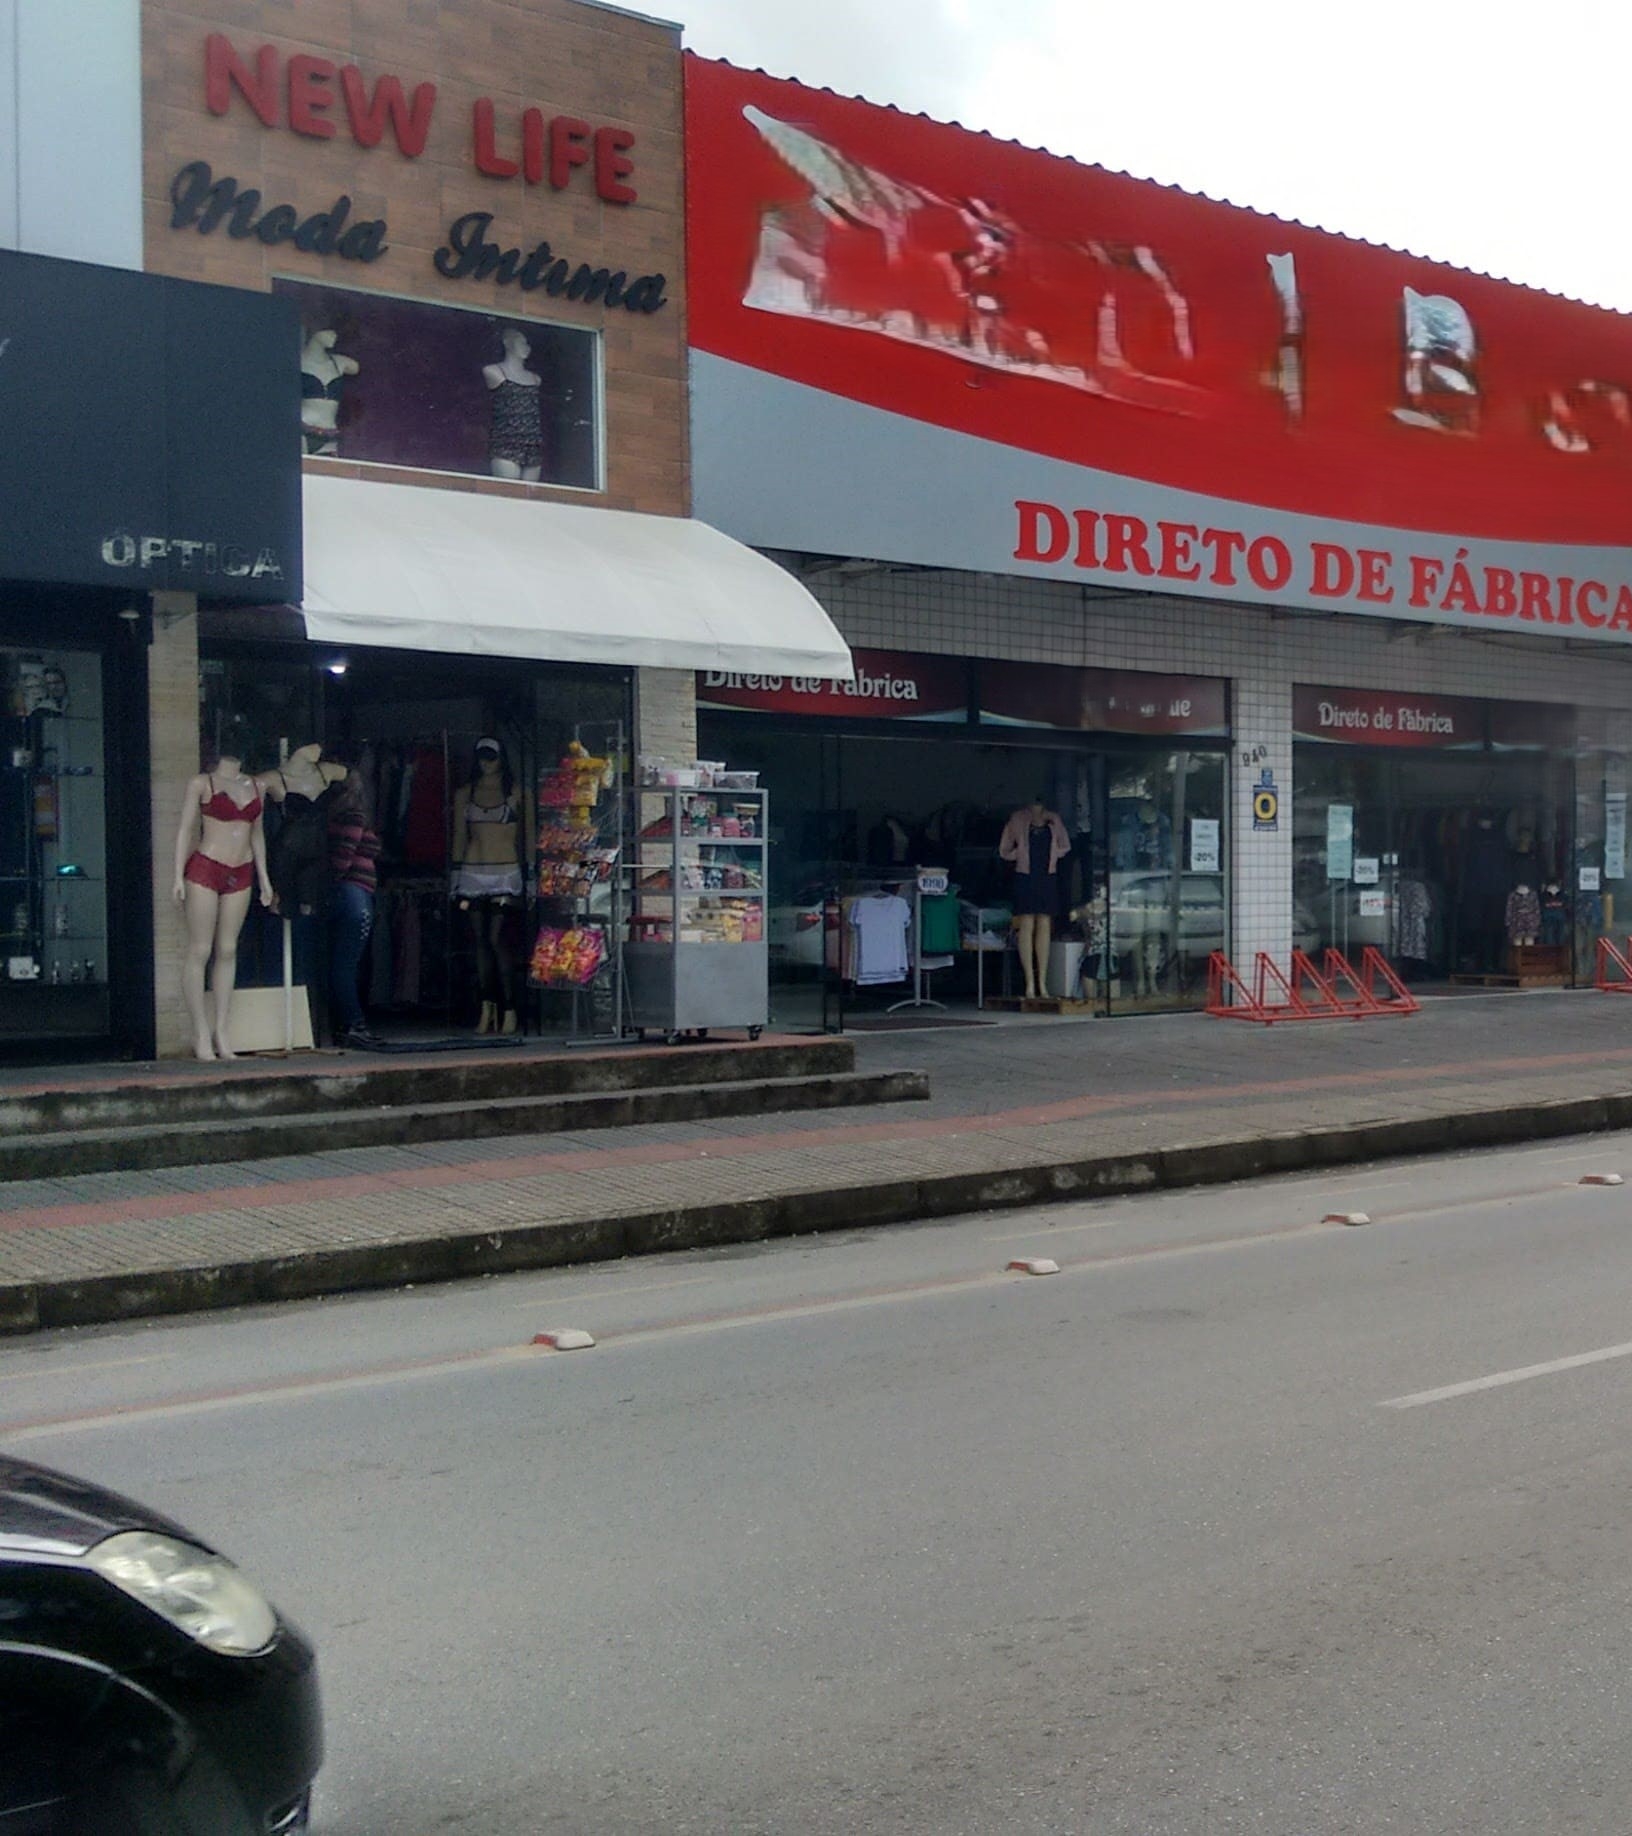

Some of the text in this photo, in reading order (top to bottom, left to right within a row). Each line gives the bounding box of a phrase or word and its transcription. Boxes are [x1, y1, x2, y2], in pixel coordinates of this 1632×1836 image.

[206, 33, 638, 203] NEW LIFE
[170, 159, 390, 263] Moda
[1014, 500, 1292, 591] DIRETO
[1309, 541, 1394, 603] DE
[1318, 702, 1369, 728] Direto
[1373, 707, 1393, 729] de
